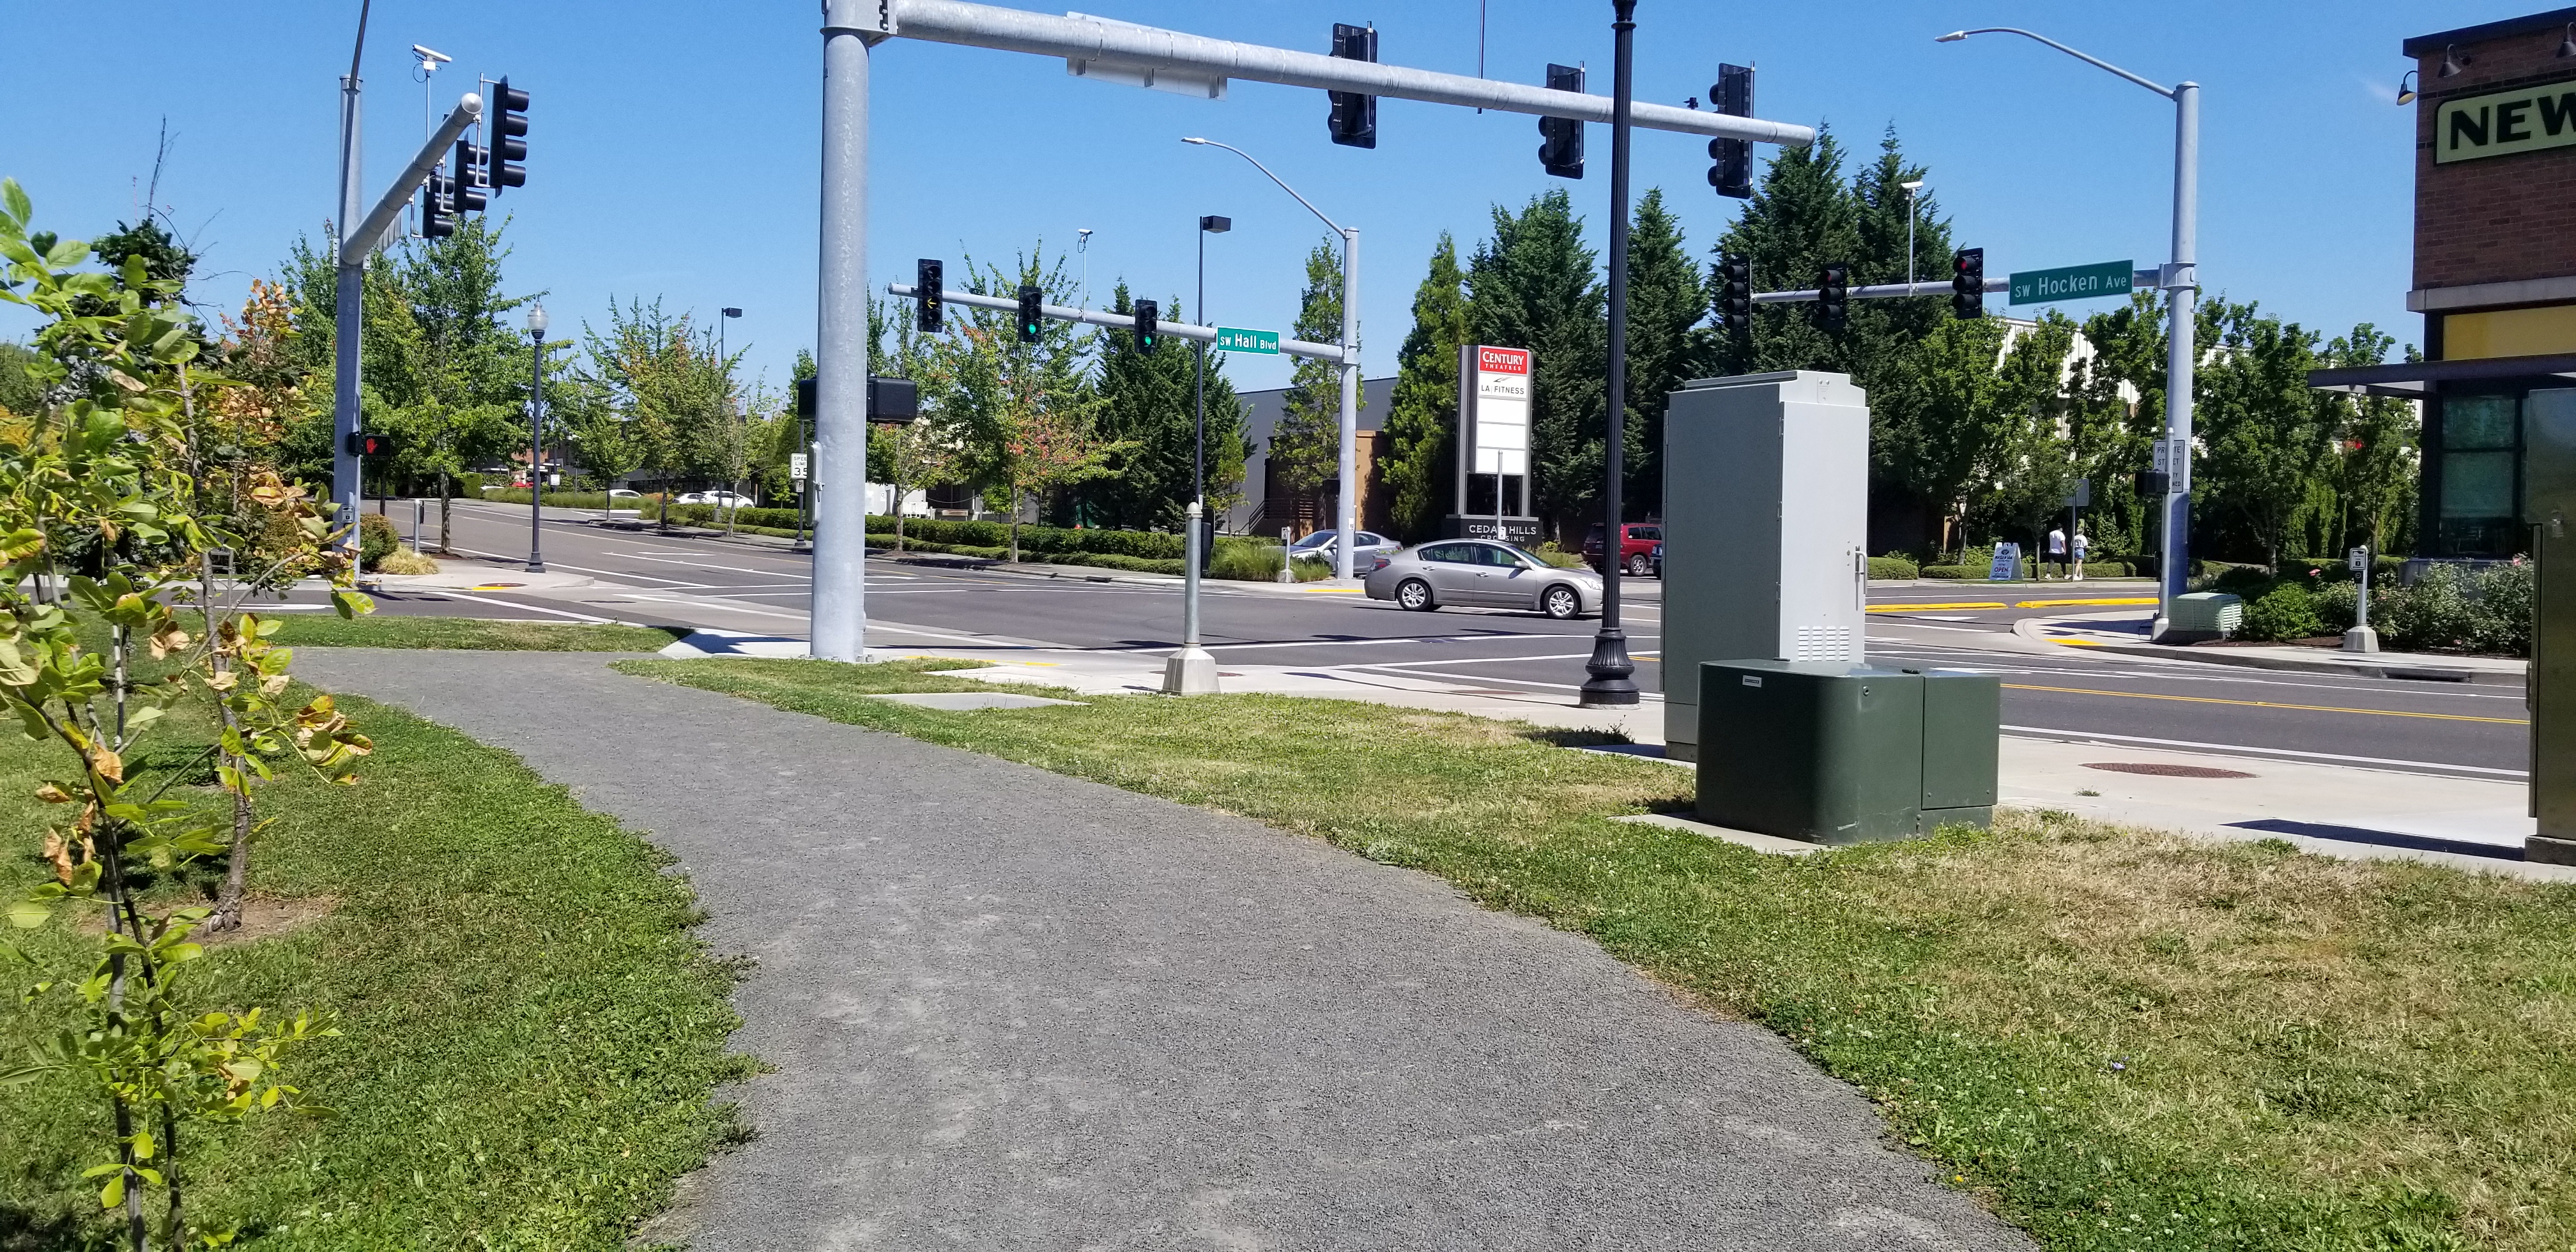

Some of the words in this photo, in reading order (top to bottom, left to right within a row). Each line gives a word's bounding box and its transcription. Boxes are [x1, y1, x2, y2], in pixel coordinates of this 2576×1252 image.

[2450, 92, 2576, 150] NEW
[2014, 284, 2030, 298] SW
[2038, 275, 2097, 296] Hocken
[2106, 275, 2127, 289] Ave
[1220, 336, 1232, 347] SW
[1235, 333, 1257, 349] Hall
[1260, 339, 1276, 350] Blvd
[1482, 351, 1524, 365] CENTURY
[1494, 386, 1524, 395] FITNESS
[1469, 524, 1498, 534] CEDA
[1508, 526, 1537, 535] HILLS
